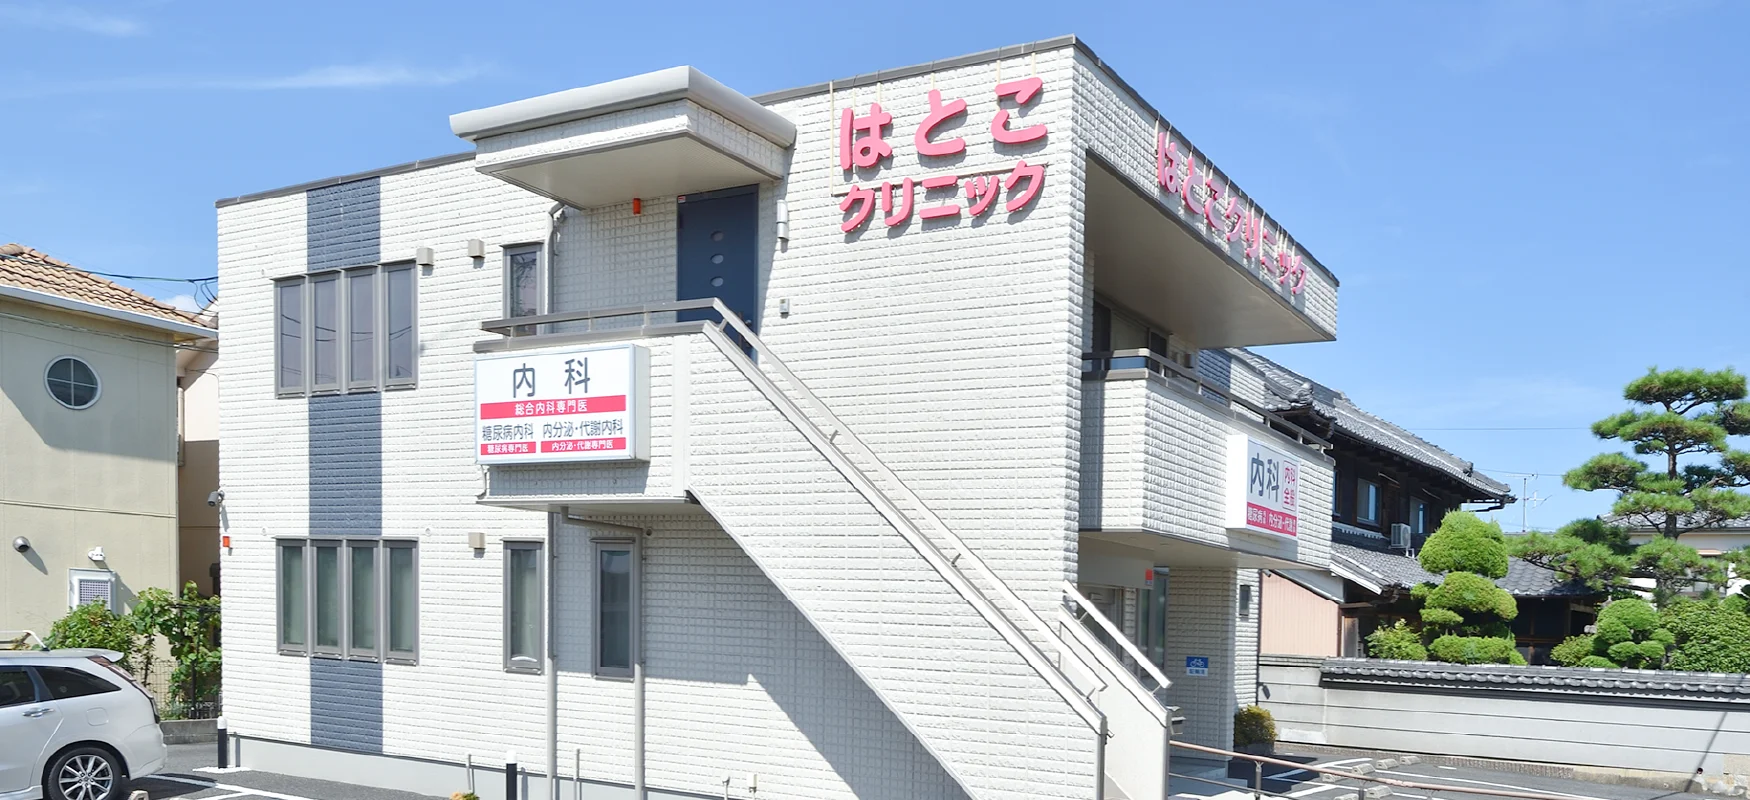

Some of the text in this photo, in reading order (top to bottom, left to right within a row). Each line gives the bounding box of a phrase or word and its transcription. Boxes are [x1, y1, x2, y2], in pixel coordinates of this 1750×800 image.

[840, 77, 1047, 170] はとこ
[840, 160, 1045, 233] クリニック
[1157, 131, 1307, 294] はとこクリニック
[513, 357, 590, 398] 内科
[482, 418, 623, 441] 糖尿病内科 内分泌・代謝内科
[514, 399, 588, 416] 総合内科専門医
[1250, 453, 1280, 503] 内科
